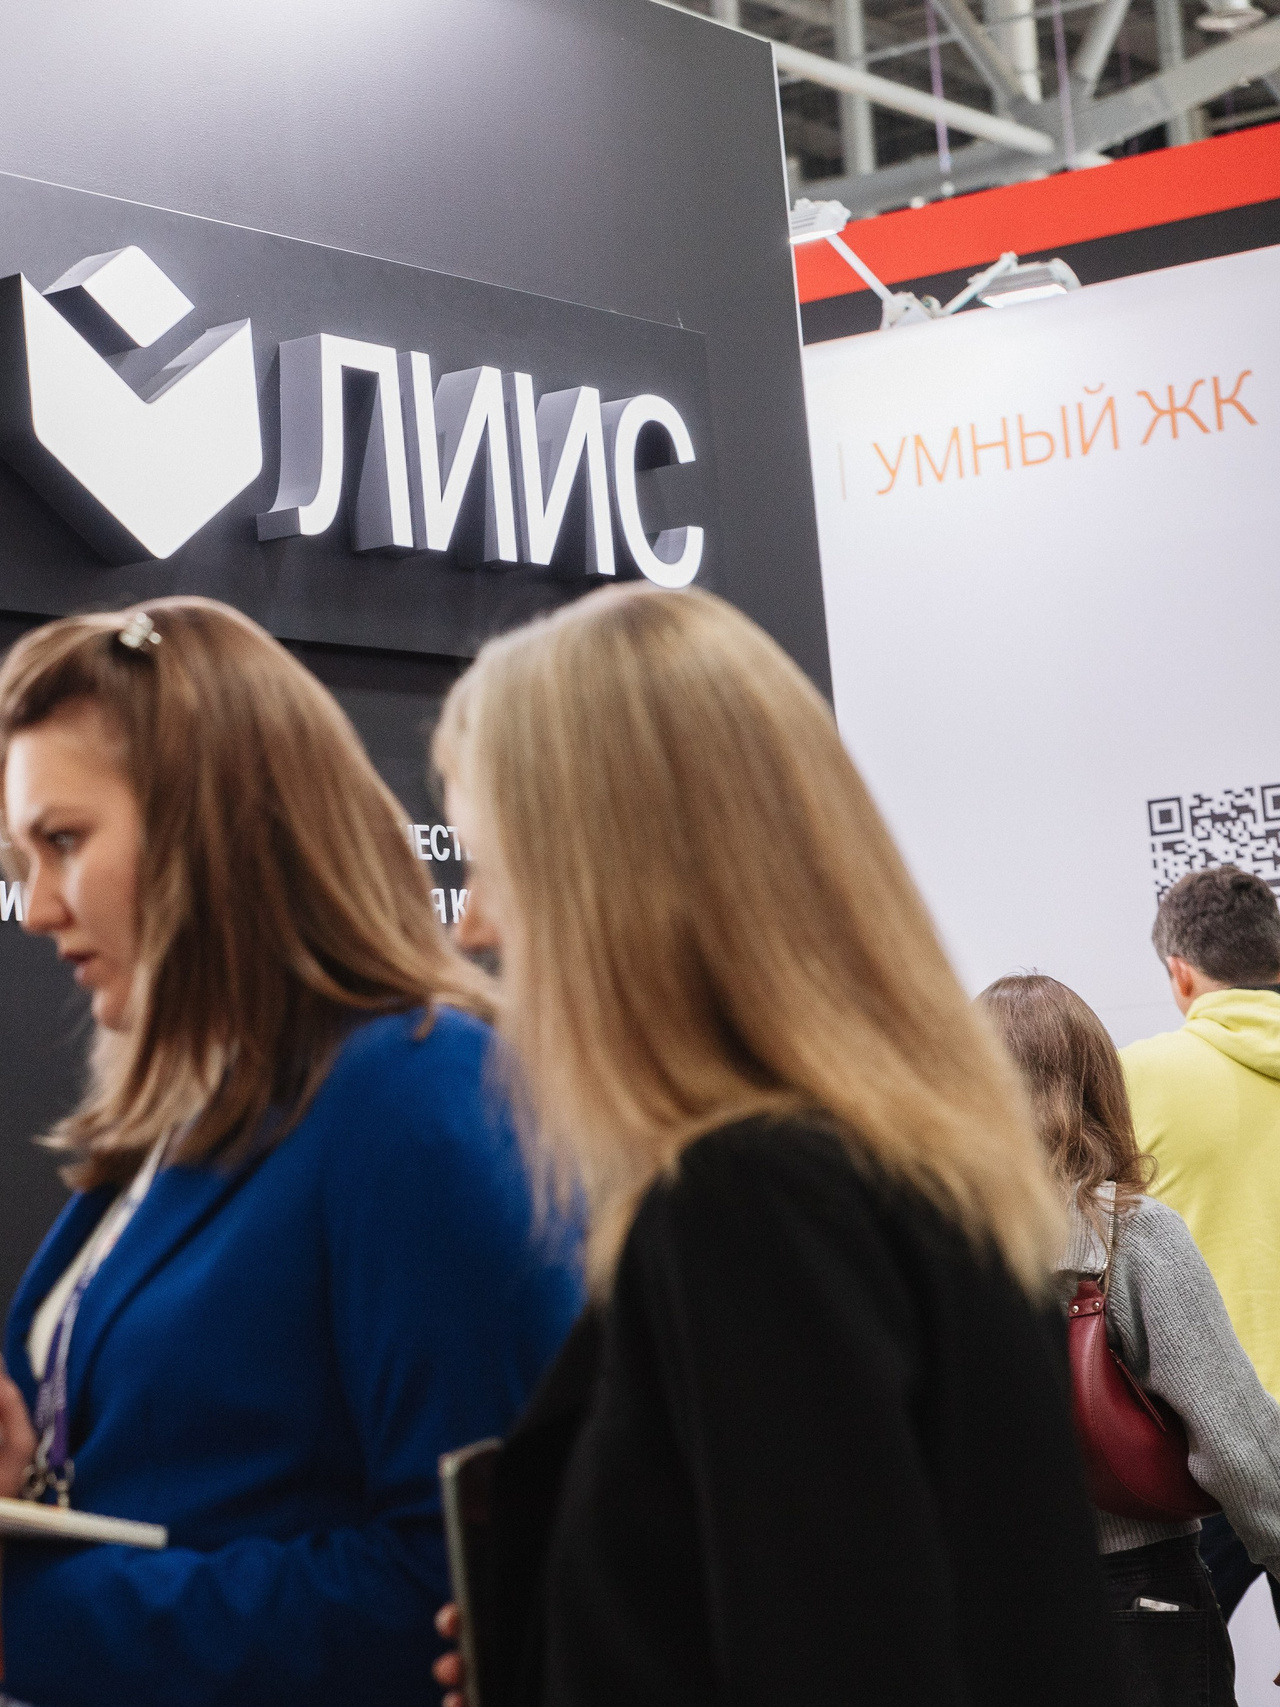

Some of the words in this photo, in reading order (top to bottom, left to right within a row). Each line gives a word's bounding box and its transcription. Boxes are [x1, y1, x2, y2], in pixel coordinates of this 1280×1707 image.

[292, 332, 704, 590] ЛИИС
[871, 382, 1121, 496] УМНЫЙ
[1135, 368, 1260, 447] ЖК
